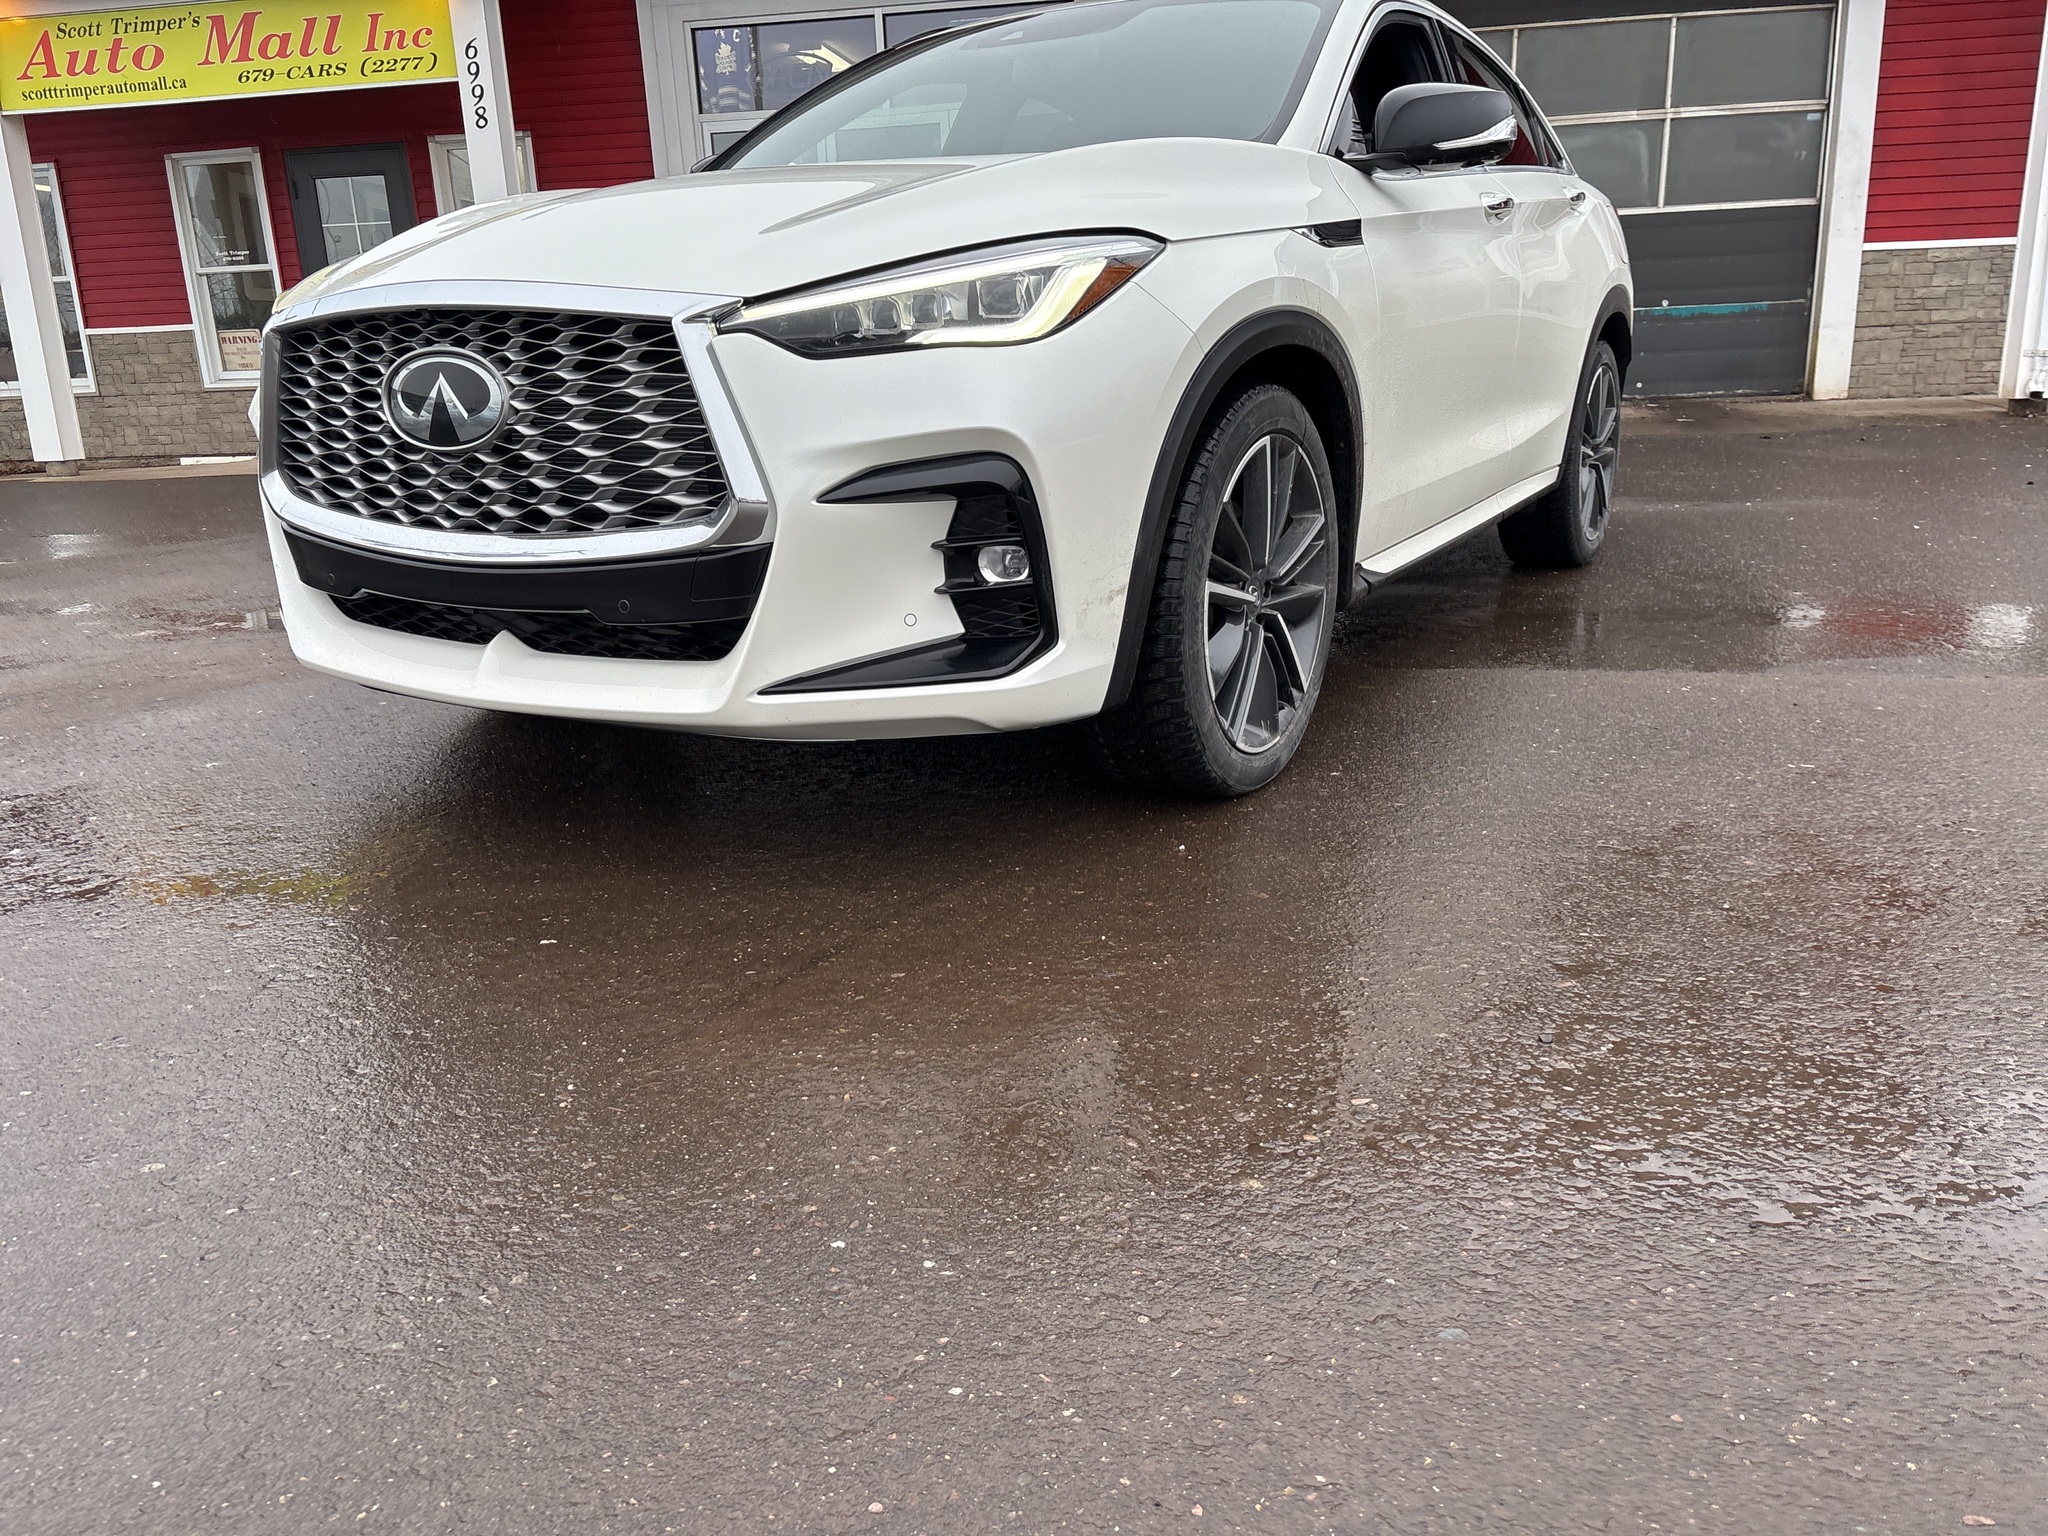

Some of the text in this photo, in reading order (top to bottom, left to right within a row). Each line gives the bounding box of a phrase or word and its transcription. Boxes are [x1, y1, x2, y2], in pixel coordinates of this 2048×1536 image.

[56, 11, 201, 40] Scott Trimper's
[16, 10, 434, 81] Auto Mall Inc
[237, 52, 438, 84] 679-CARS (2277)
[464, 37, 489, 129] 6998
[21, 76, 187, 101] scotttrimperautomall.ca
[220, 336, 258, 344] WARNING
